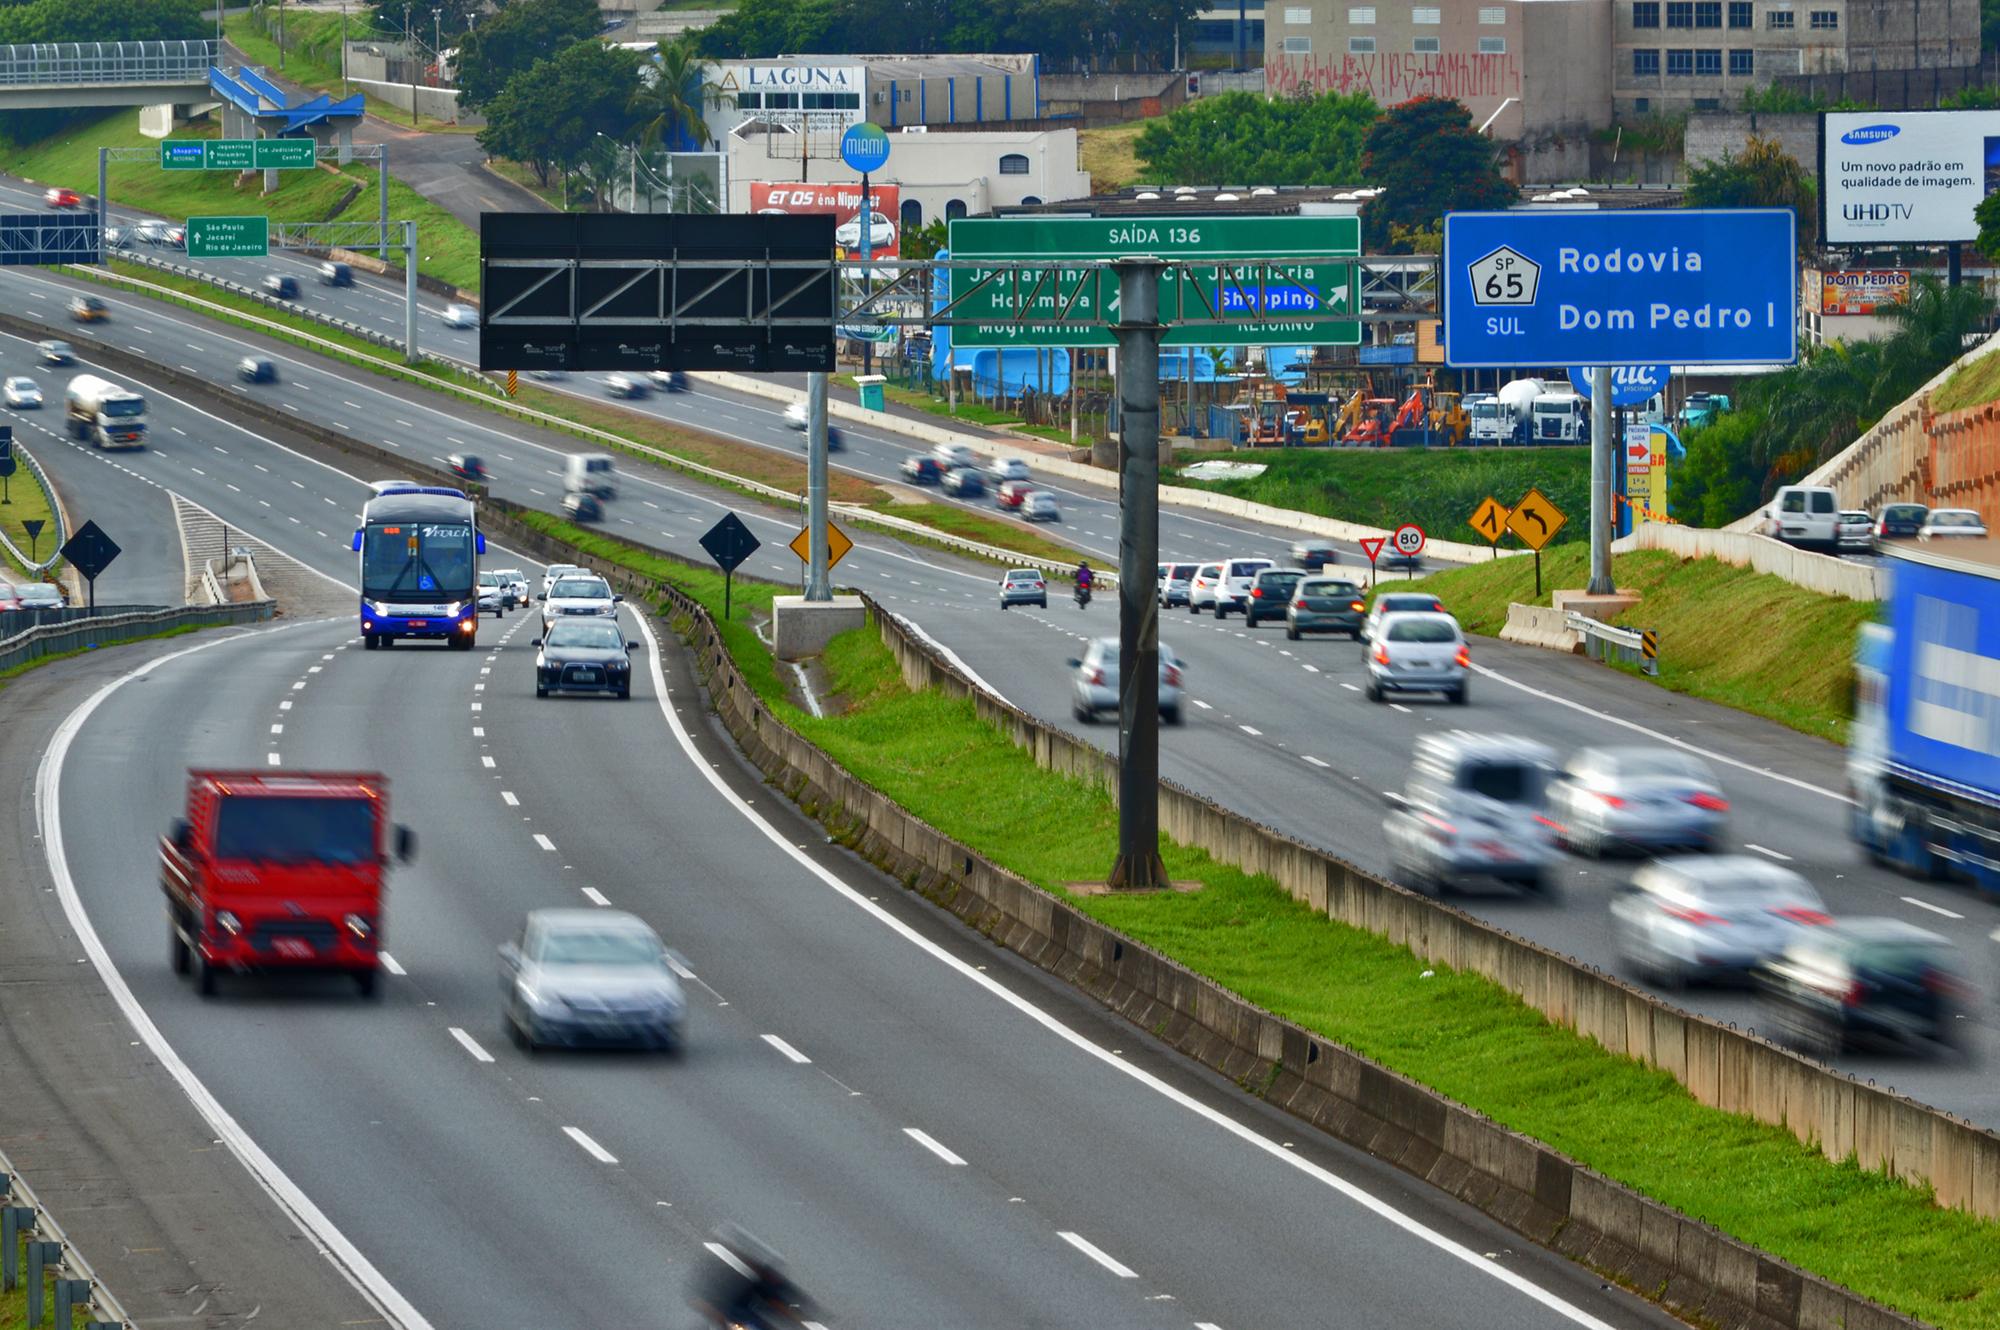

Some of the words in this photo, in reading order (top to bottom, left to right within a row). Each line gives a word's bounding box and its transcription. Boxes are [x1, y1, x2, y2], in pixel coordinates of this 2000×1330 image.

[749, 67, 848, 85] LAGUNA
[1848, 130, 1894, 139] SAMSUNG
[846, 138, 884, 155] MIAMI
[1841, 161, 1863, 172] Um
[1866, 163, 1896, 172] novo
[1899, 160, 1941, 174] padrão
[1944, 162, 1964, 171] em
[1841, 176, 1902, 189] qualidade
[1904, 176, 1919, 187] de
[1922, 176, 1975, 189] imagem.
[818, 193, 823, 206] é
[825, 197, 835, 206] na
[1843, 203, 1890, 221] UHD
[1891, 203, 1914, 220] TV
[206, 223, 220, 231] São
[222, 223, 245, 231] Paulo
[1109, 223, 1160, 244] SAÍDA
[1169, 228, 1201, 244] 136
[206, 233, 236, 241] Jacareí
[1495, 257, 1515, 271] SP
[1559, 246, 1702, 273] Rodovia
[1485, 273, 1524, 299] 65
[1826, 274, 1859, 286] DOM
[1862, 274, 1907, 286] PEDRO
[1559, 303, 1635, 330] Dom
[1650, 302, 1752, 329] Pedro
[1767, 301, 1775, 328] I
[1486, 316, 1526, 335] SUL
[1623, 385, 1652, 393] piscinas
[1628, 466, 1649, 474] ENTRADA
[1400, 533, 1419, 545] 80
